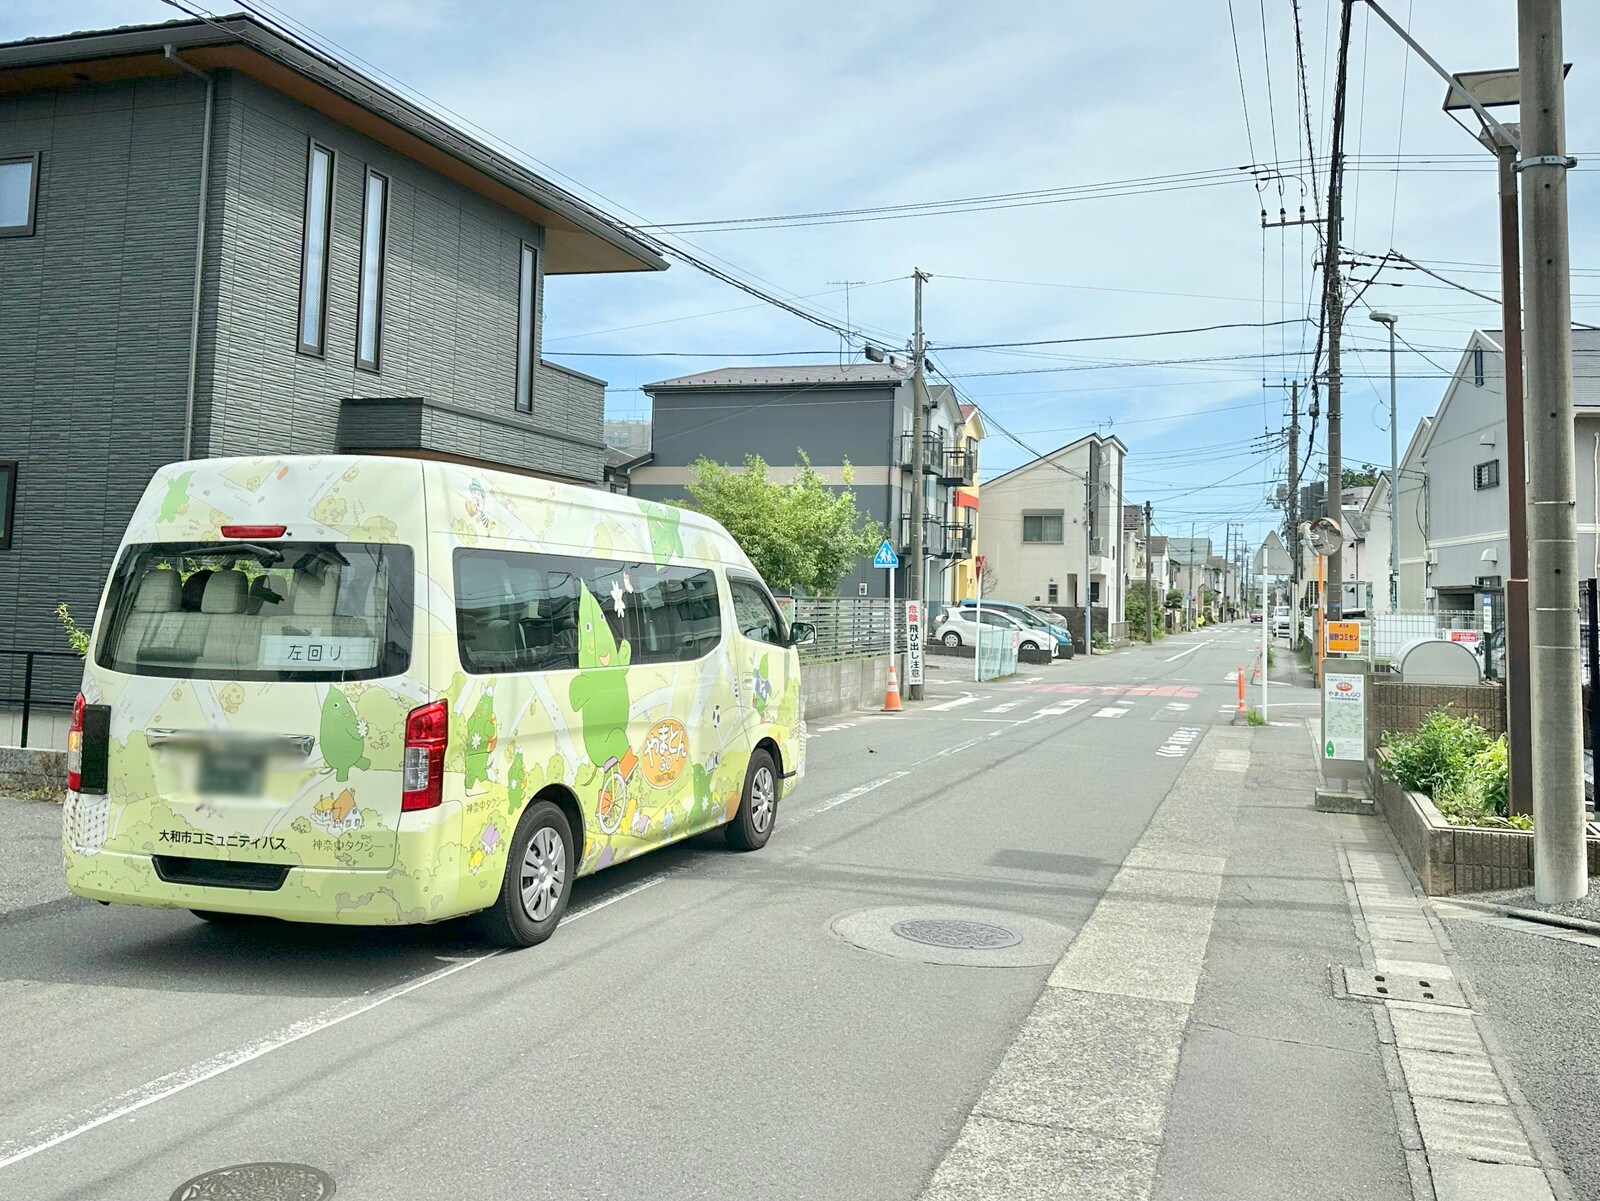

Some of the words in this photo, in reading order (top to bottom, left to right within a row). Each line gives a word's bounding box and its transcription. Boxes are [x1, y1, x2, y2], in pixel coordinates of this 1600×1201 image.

[287, 644, 342, 662] 左回り
[644, 723, 688, 768] やまとん
[659, 754, 673, 772] GO
[466, 796, 507, 815] 神奈中タクシー
[159, 829, 286, 851] 大和市コミュニティバス
[312, 838, 385, 852] 神奈中タクシー
